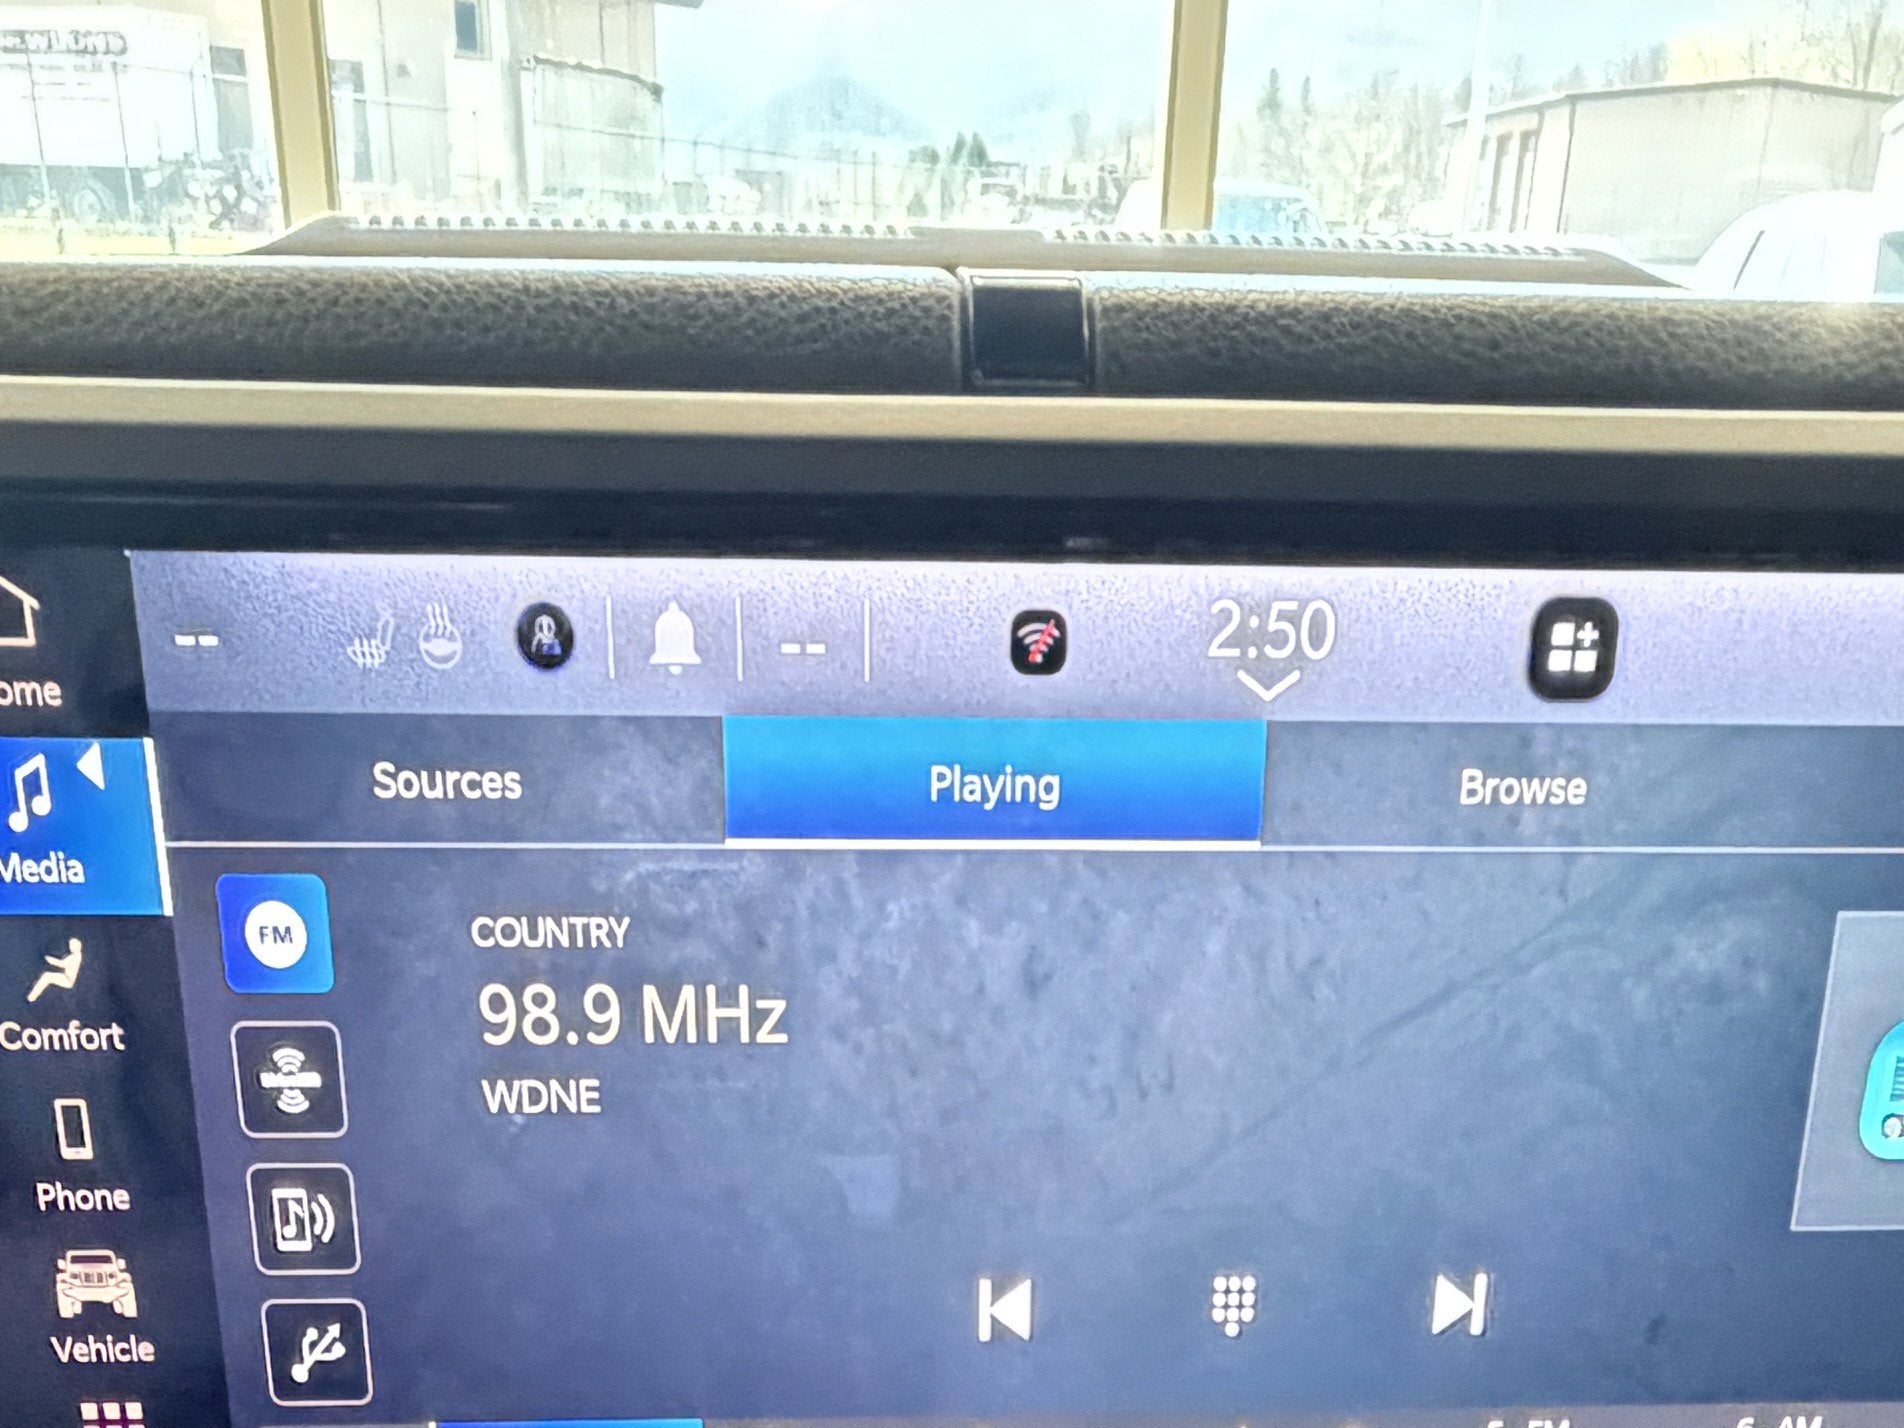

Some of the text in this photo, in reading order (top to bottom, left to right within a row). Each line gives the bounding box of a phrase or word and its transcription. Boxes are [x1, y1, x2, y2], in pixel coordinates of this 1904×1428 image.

[1207, 598, 1337, 660] 2:50
[372, 760, 523, 802] Sources
[930, 765, 1061, 811] Playing
[1460, 767, 1588, 806] Browse
[258, 923, 294, 946] FM
[471, 914, 631, 950] COUNTRY
[477, 983, 789, 1046] 98.9 MHz
[482, 1078, 602, 1116] WDNE
[36, 1181, 130, 1213] Phone
[50, 1335, 156, 1364] Vehicle
